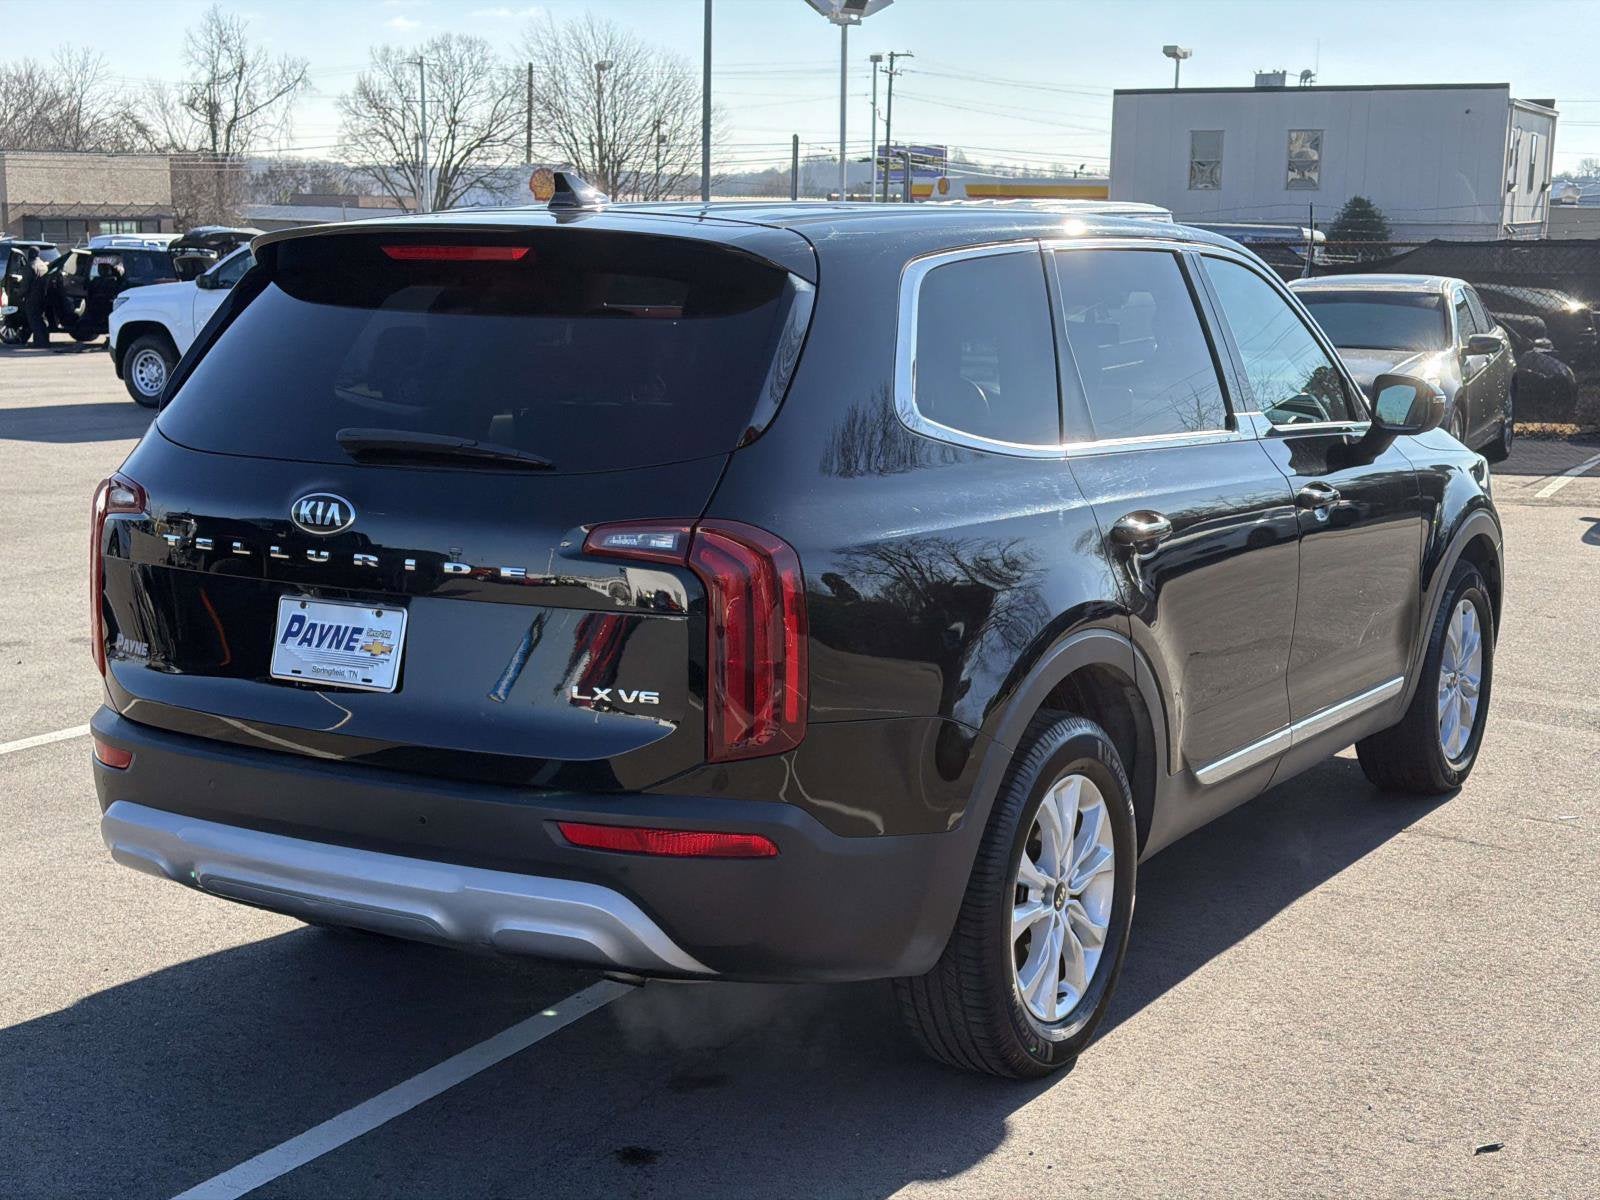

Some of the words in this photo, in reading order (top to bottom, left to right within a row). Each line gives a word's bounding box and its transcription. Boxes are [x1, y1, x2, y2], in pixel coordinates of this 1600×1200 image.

[300, 500, 341, 526] KIA
[163, 534, 527, 577] TELLURIDE
[280, 614, 364, 651] PAYNE
[349, 669, 359, 679] TN
[571, 685, 612, 702] LX
[618, 689, 660, 705] V6
